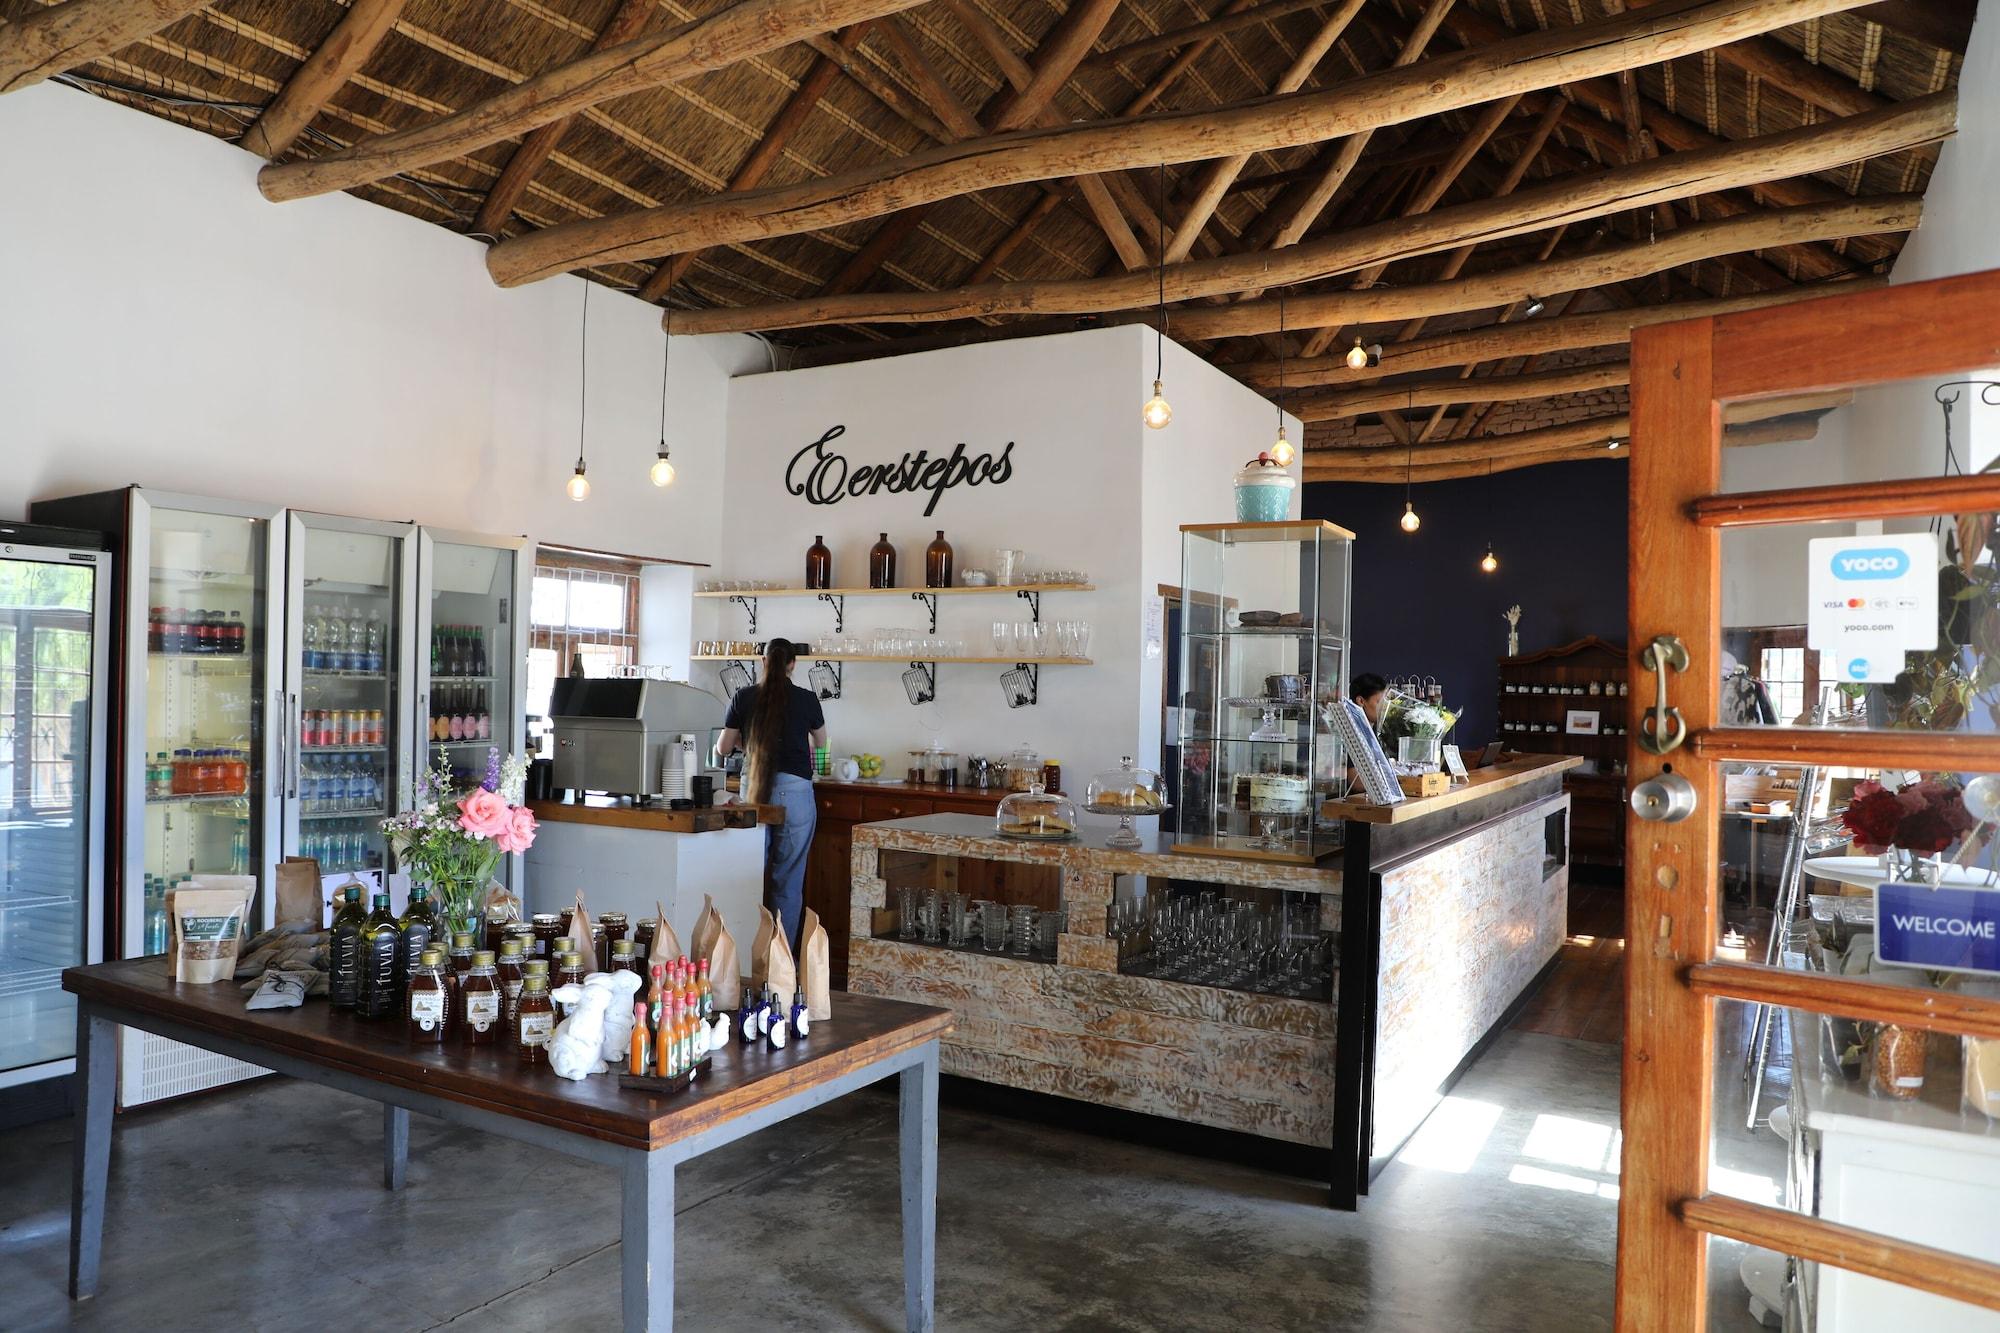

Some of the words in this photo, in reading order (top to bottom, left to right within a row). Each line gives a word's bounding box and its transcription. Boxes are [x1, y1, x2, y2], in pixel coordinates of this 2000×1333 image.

[786, 424, 1015, 517] Eerstepos
[1841, 556, 1899, 572] YOCO
[1824, 600, 1844, 609] VISA
[1844, 623, 1894, 633] yoco.com
[1892, 914, 1996, 939] WELCOME
